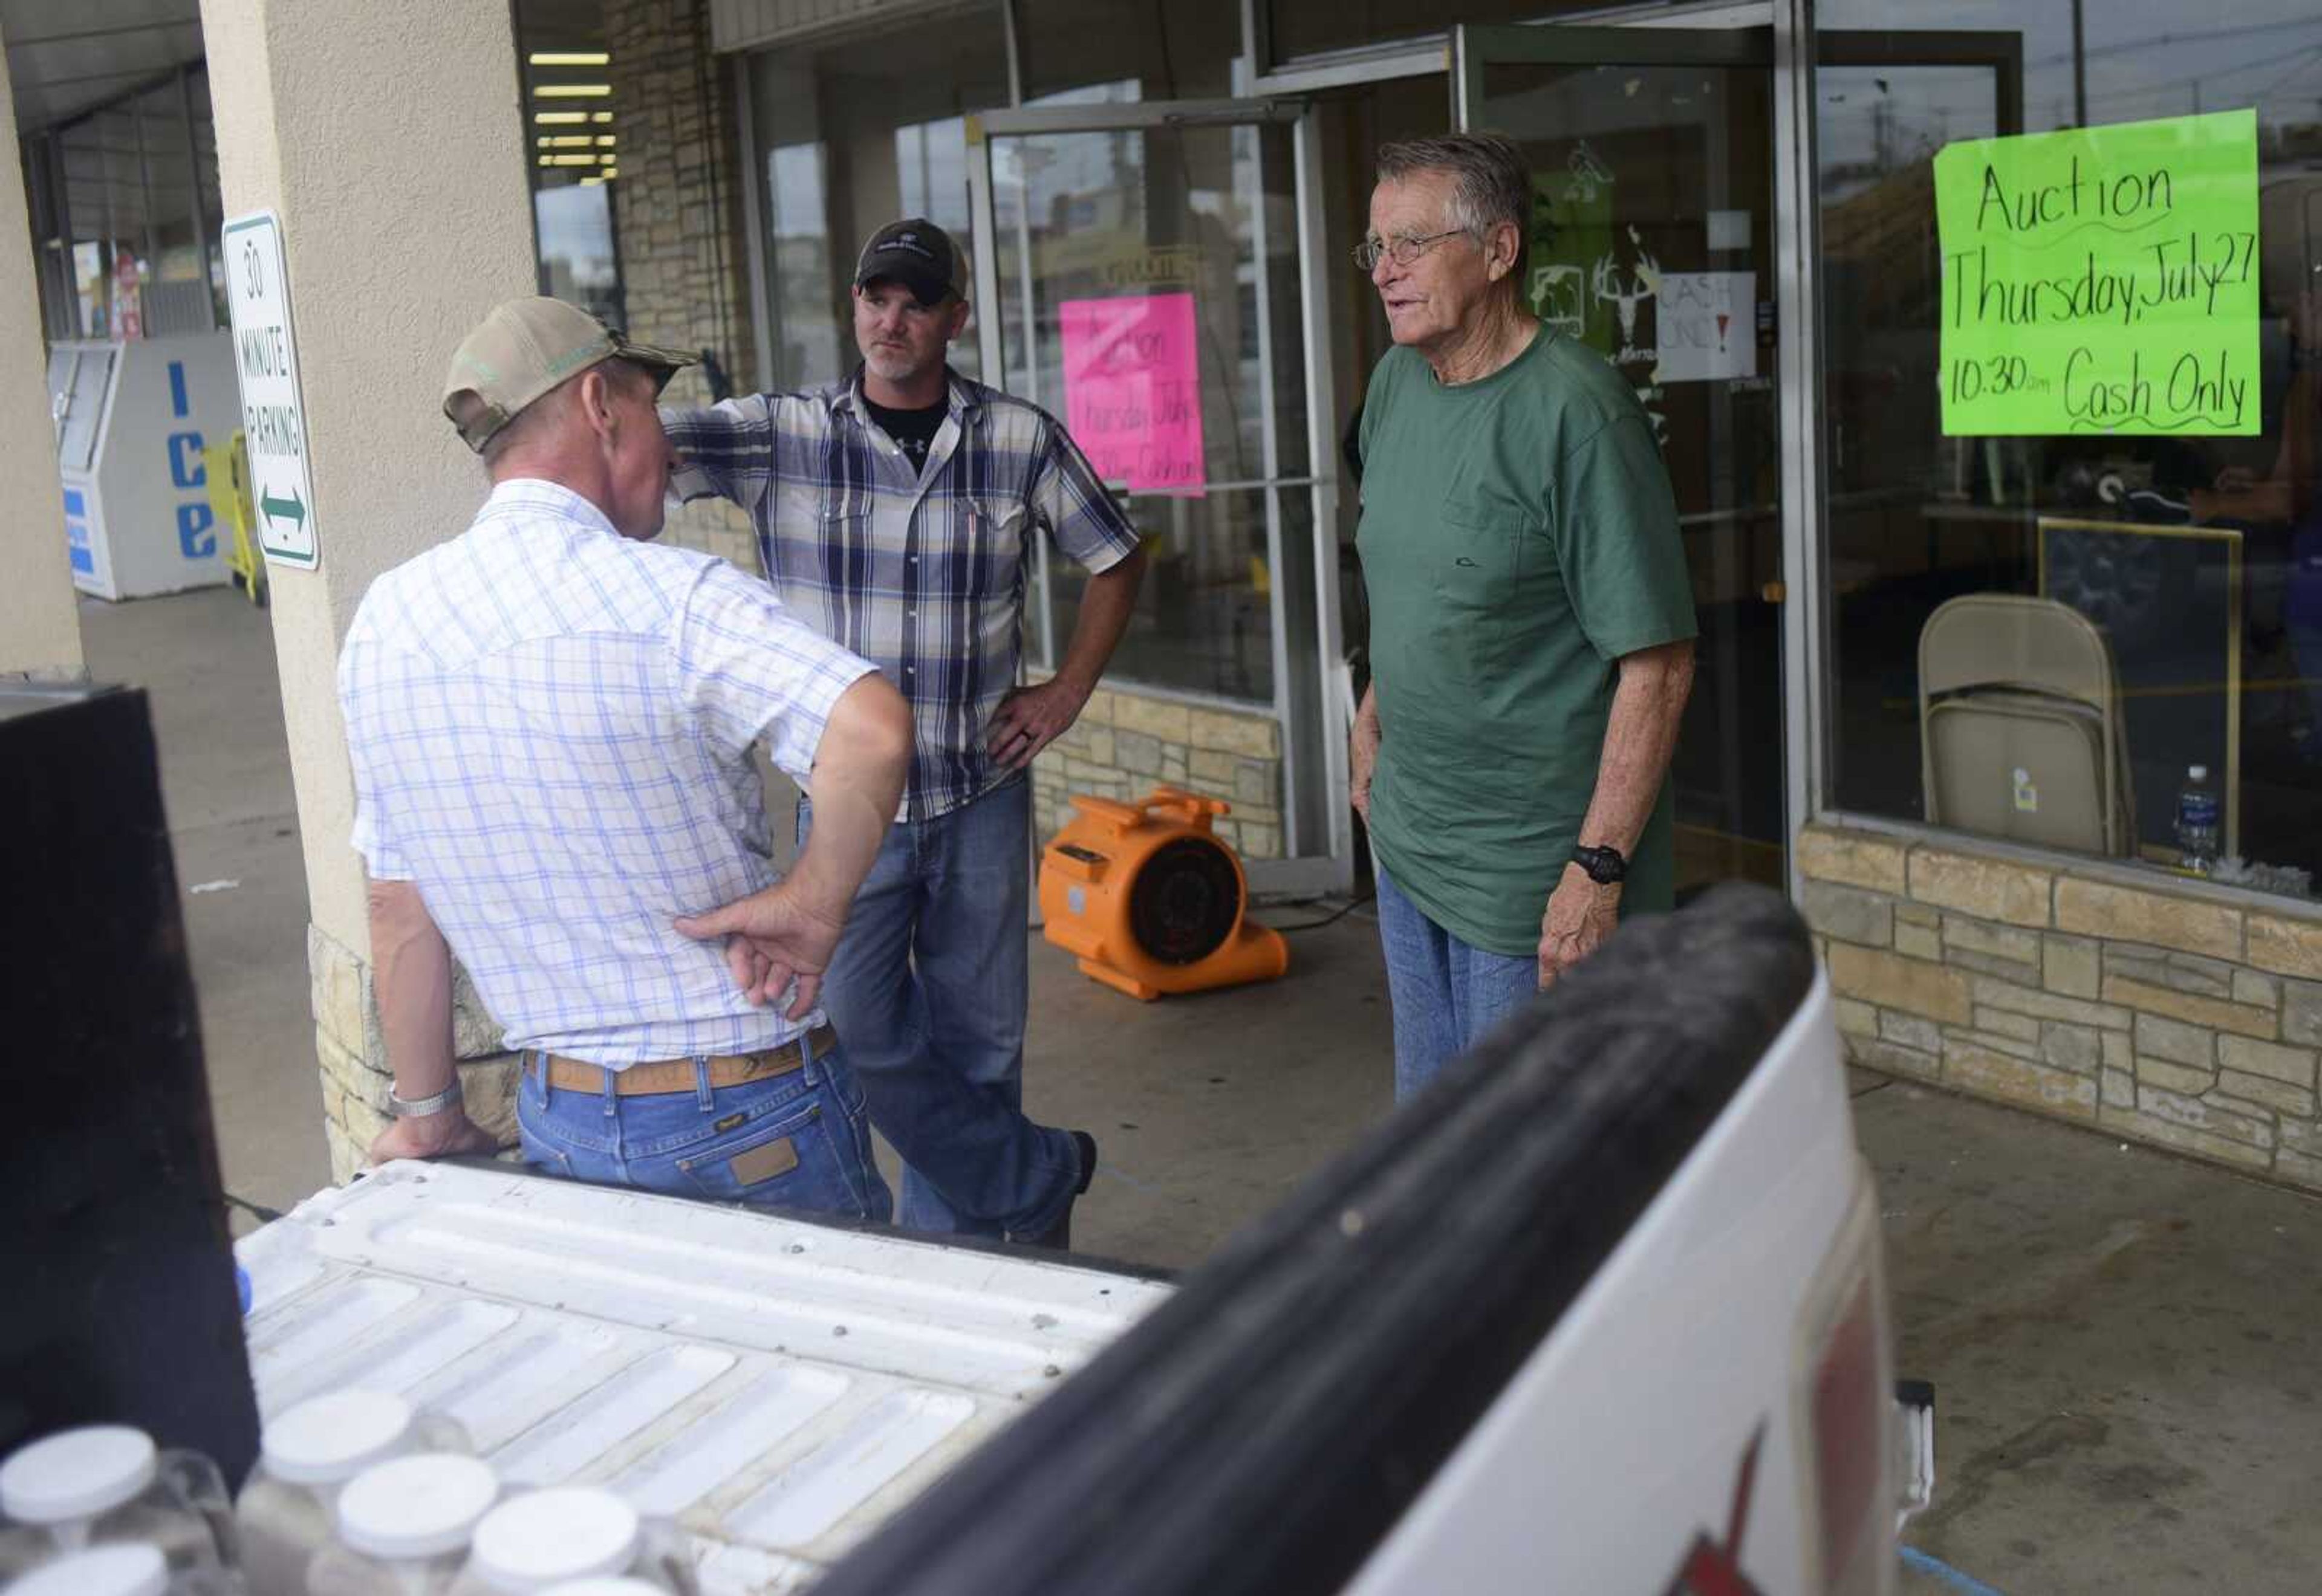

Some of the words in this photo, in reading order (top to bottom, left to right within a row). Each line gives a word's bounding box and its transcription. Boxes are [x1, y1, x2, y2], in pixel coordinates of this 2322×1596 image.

[1977, 155, 2171, 232] Auction
[244, 241, 263, 298] 30
[1945, 245, 2141, 329] Thursday,
[2140, 232, 2218, 316] July
[2215, 232, 2255, 283] 27
[241, 326, 287, 376] MINUTE
[2065, 347, 2151, 418] Cash
[2168, 349, 2246, 423] Only
[247, 406, 299, 456] PARKING
